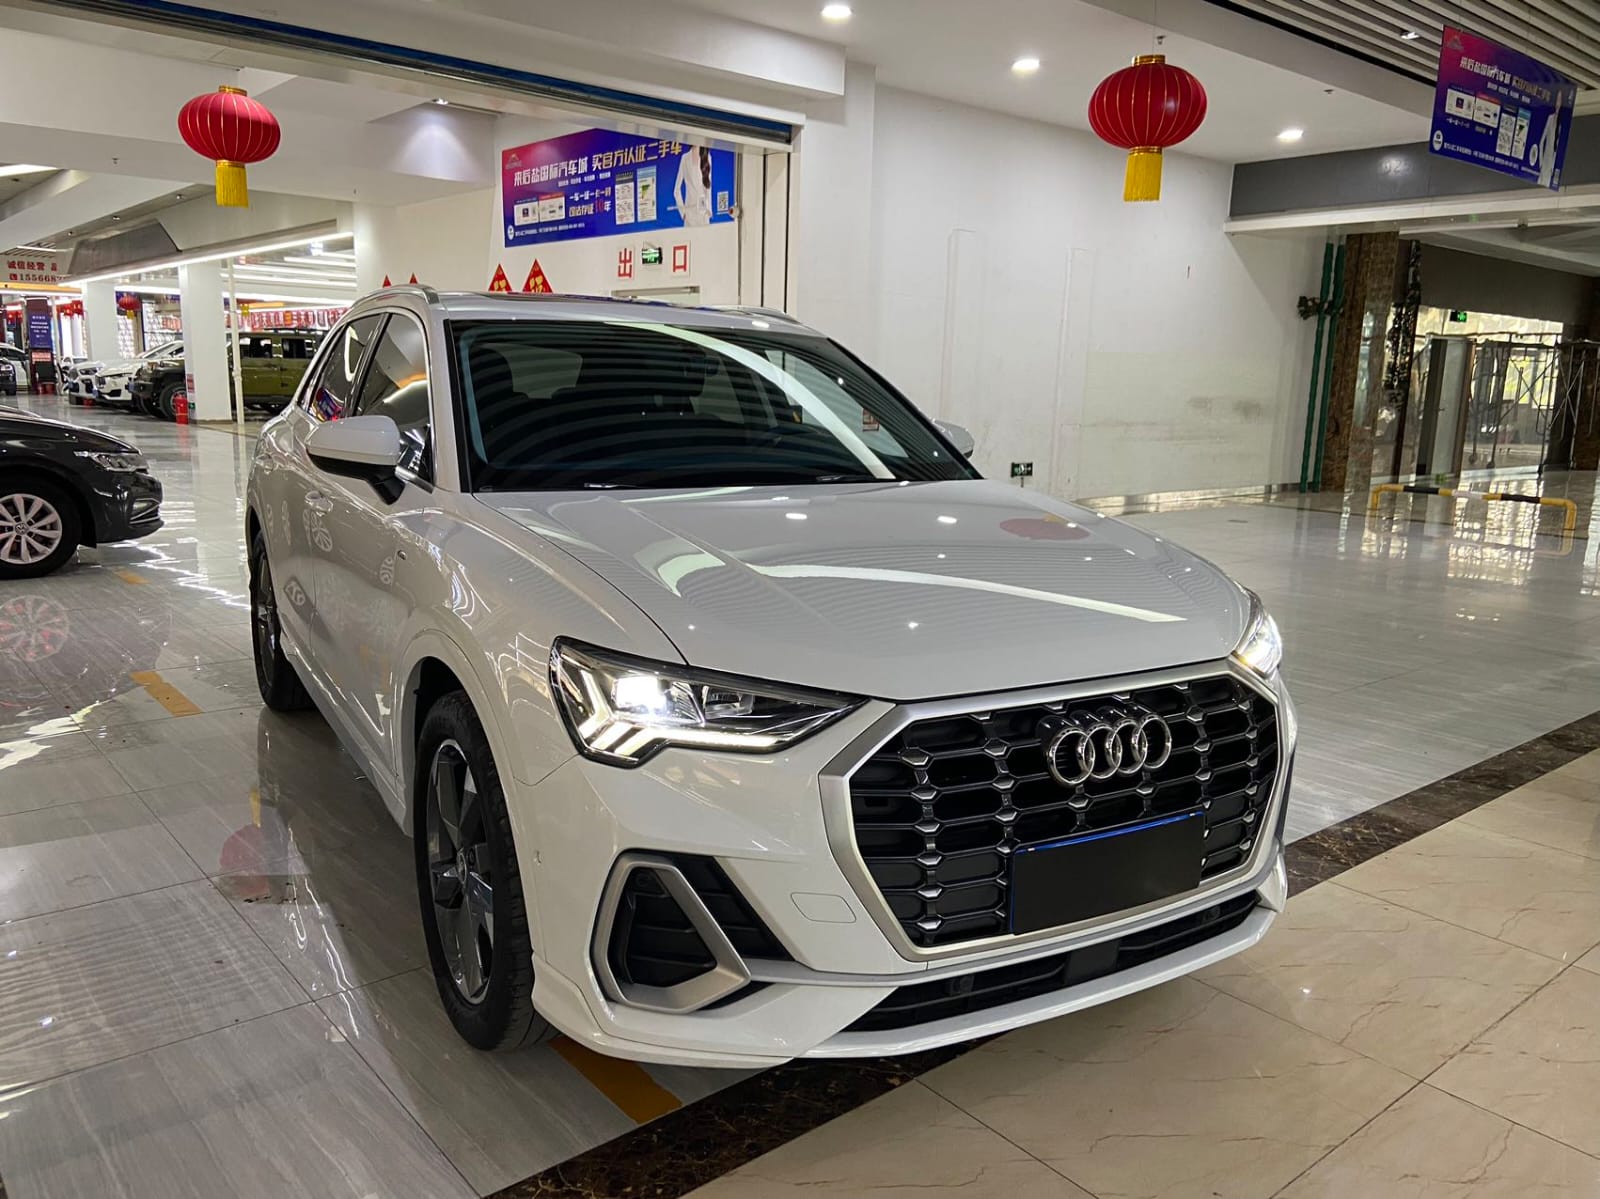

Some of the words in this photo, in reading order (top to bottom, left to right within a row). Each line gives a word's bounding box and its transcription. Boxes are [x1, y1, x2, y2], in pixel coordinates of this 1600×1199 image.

[592, 140, 682, 171] 买官方认证二手车
[617, 247, 633, 278] 出
[672, 244, 688, 272] 口
